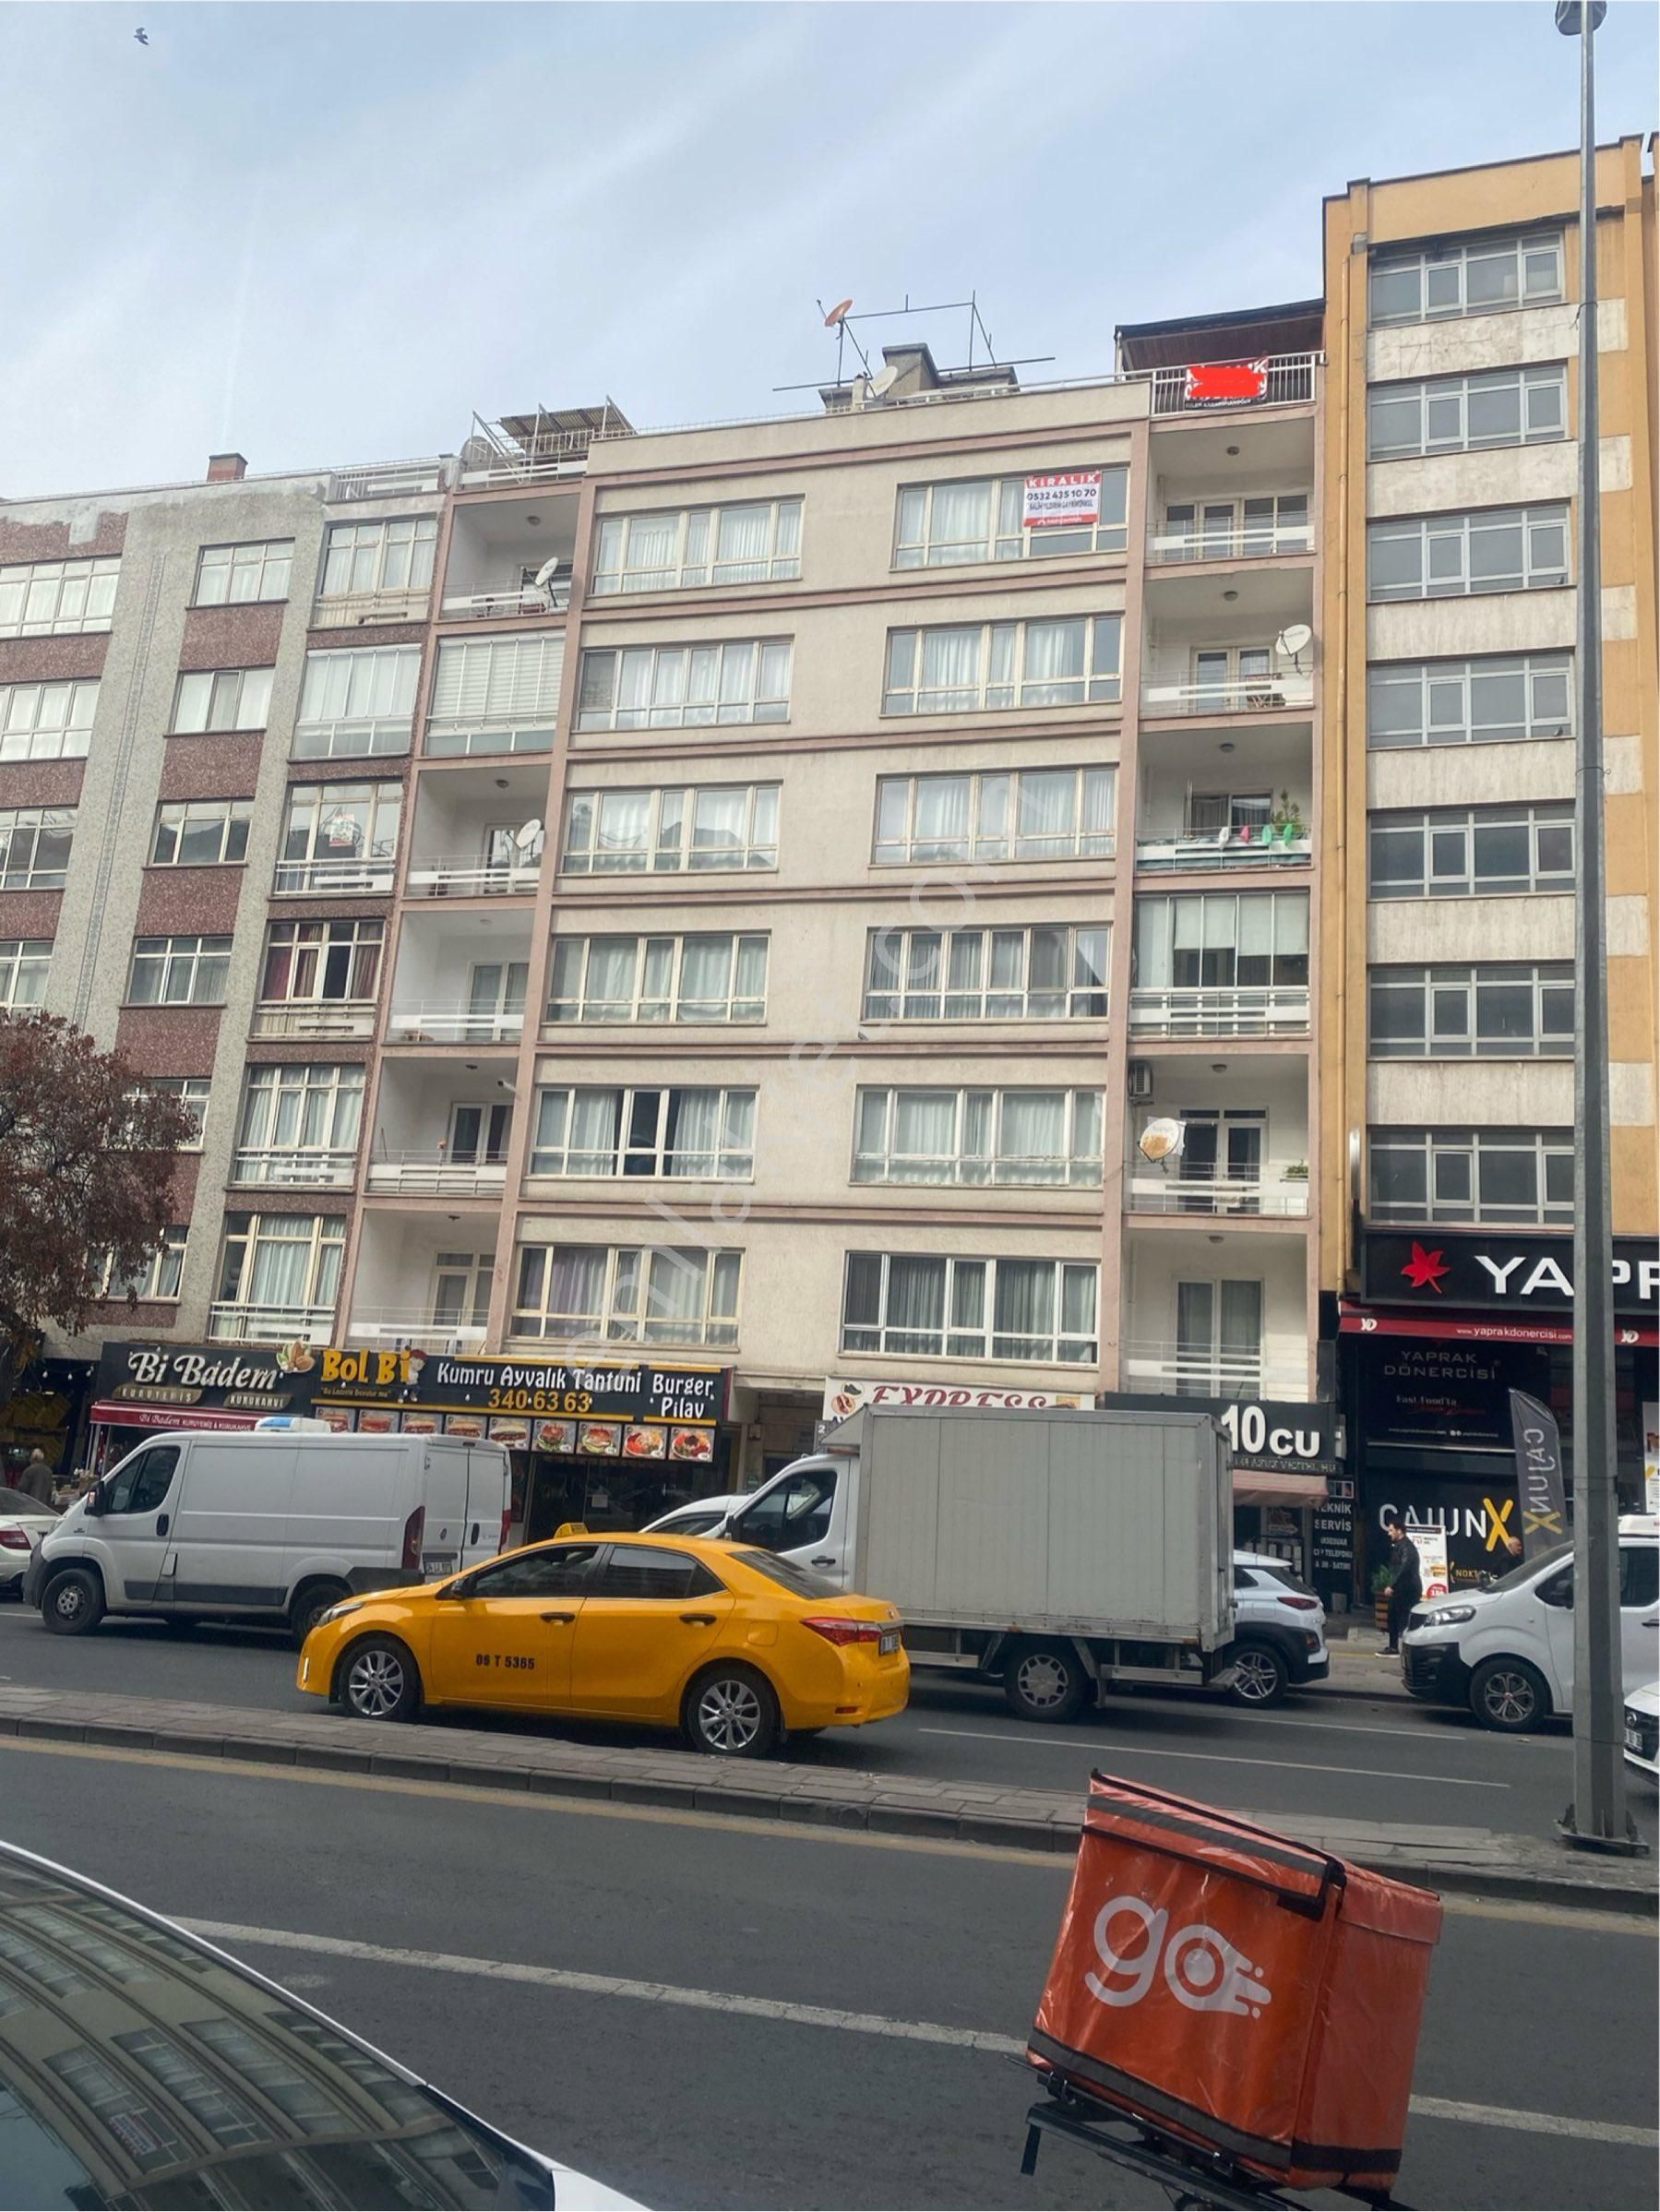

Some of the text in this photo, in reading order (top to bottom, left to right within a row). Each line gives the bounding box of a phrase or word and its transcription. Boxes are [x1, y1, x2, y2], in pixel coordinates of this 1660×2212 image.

[1028, 473, 1096, 487] KIRALIK
[1027, 488, 1096, 501] 0532 435 10 70
[321, 1348, 370, 1382] Bol
[1401, 1350, 1477, 1364] YAPRAK
[127, 1352, 277, 1391] Bi Badem
[437, 1362, 713, 1397] Kumru Ayvalık Tantuni Burger
[1384, 1362, 1496, 1380] DÖNERCİSİ
[488, 1387, 591, 1414] 340 63 63
[661, 1395, 705, 1419] Pilav
[1314, 1518, 1352, 1532] SERVİS
[495, 1655, 501, 1668] T
[1084, 1894, 1272, 2020] go
